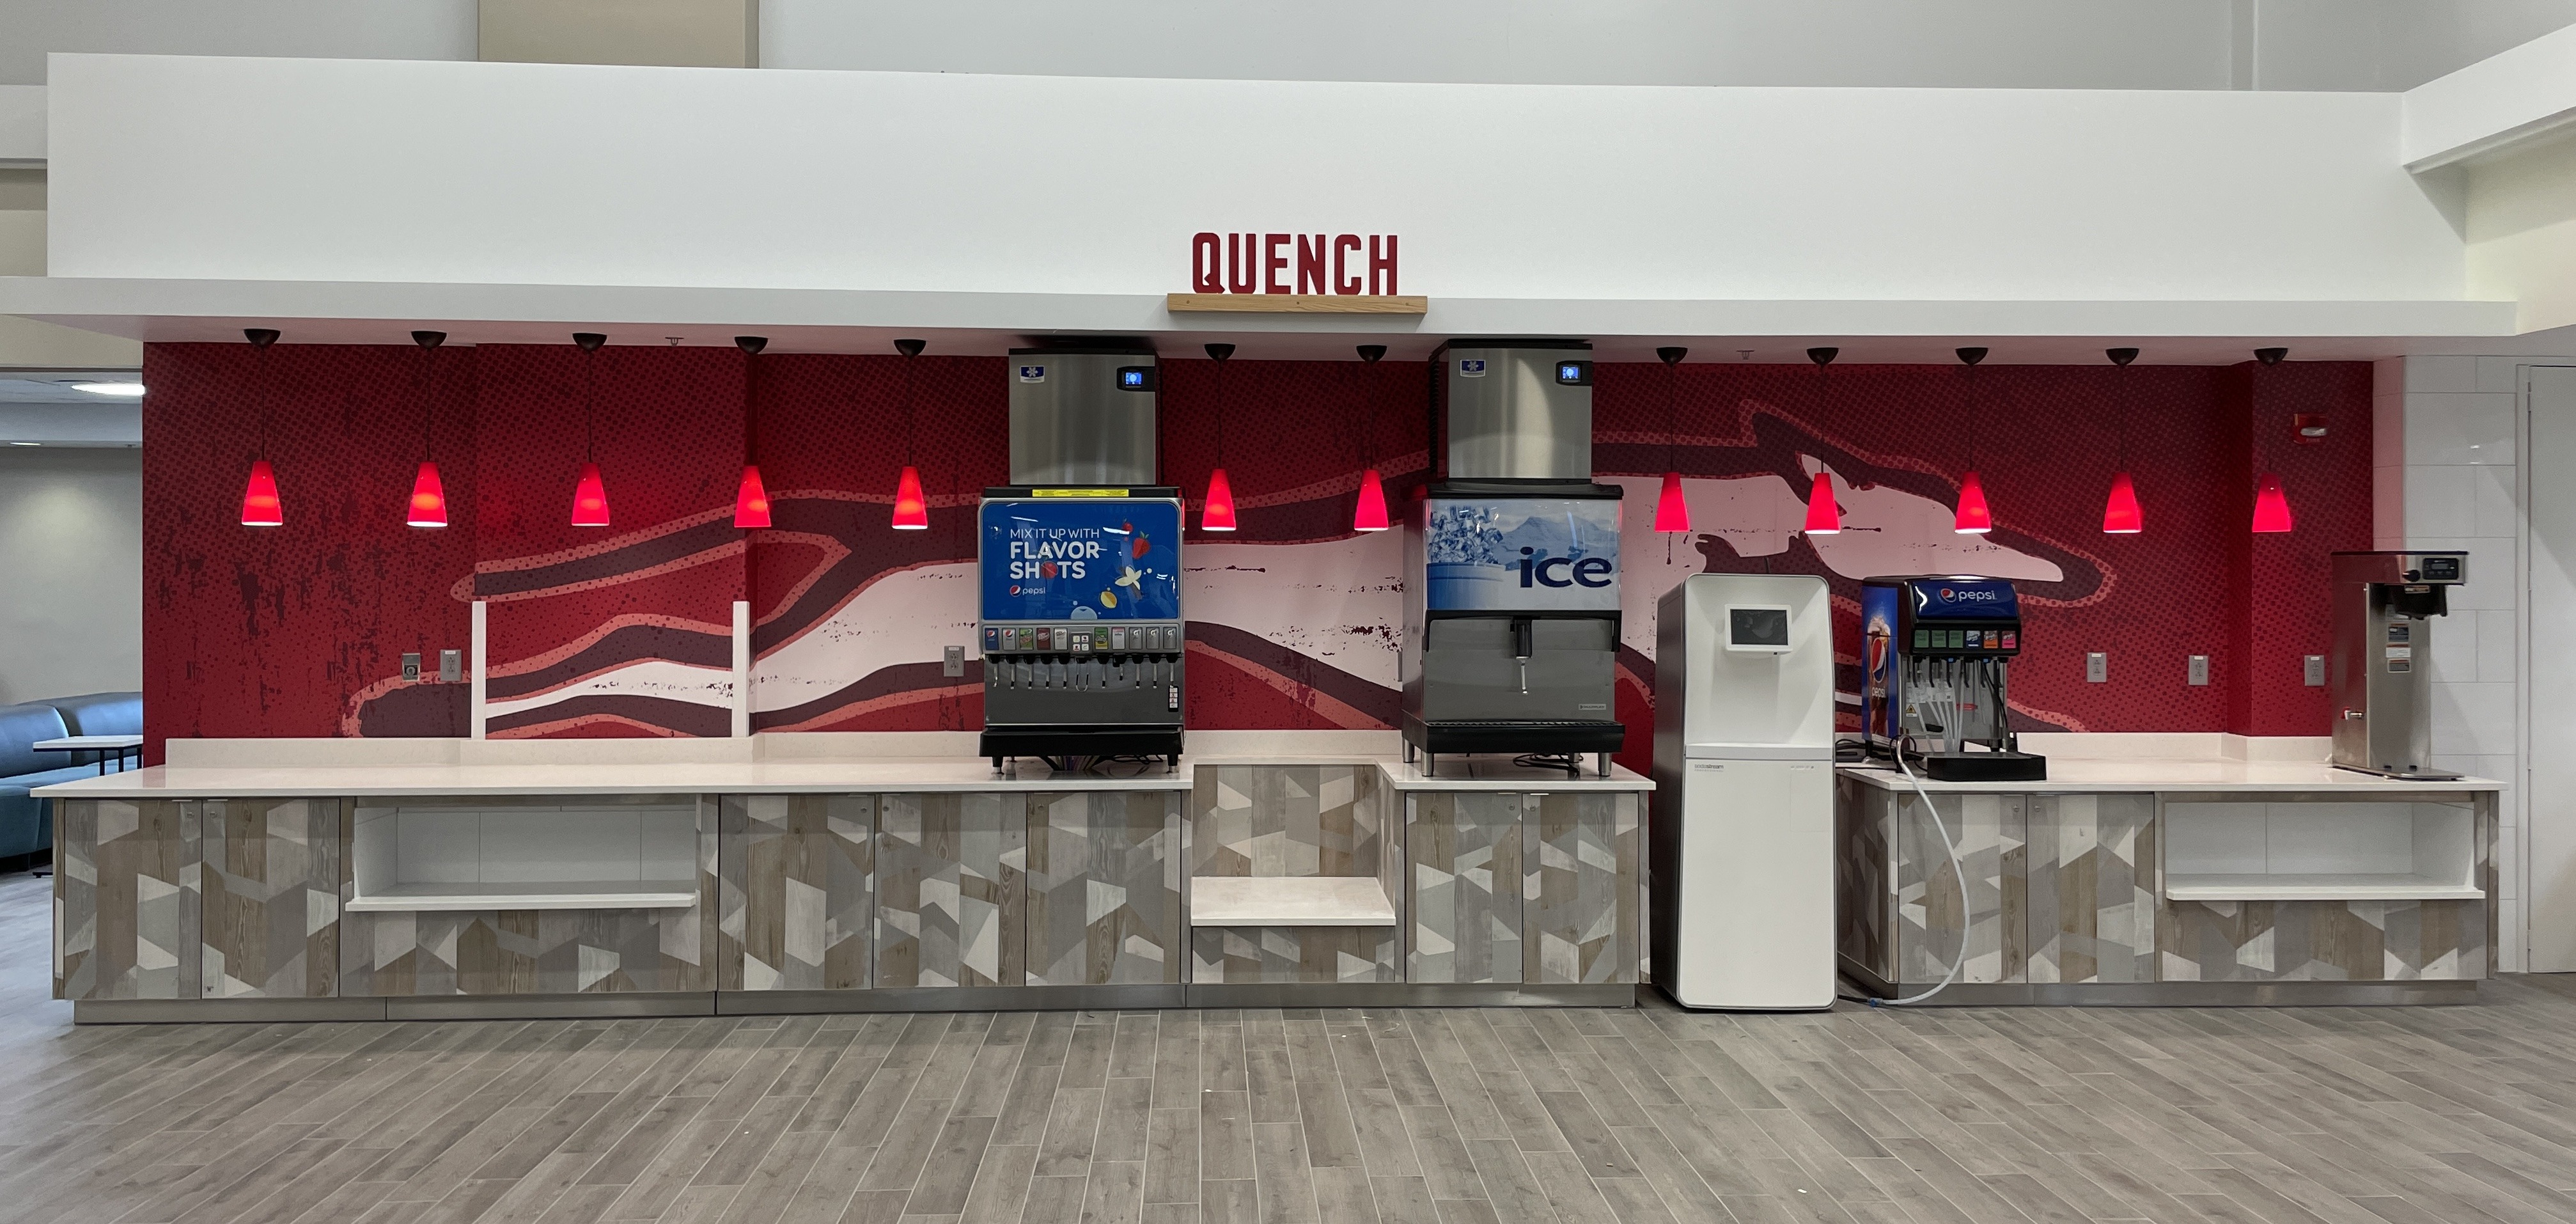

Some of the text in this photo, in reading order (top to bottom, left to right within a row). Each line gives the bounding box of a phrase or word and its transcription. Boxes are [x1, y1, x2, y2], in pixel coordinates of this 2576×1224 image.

[1192, 232, 1398, 295] QUENCH
[1010, 528, 1100, 538] MIX IT UP WITH
[1010, 541, 1100, 560] FLAVOR
[1519, 546, 1612, 588] ice
[1022, 586, 1046, 595] pepsi
[1958, 590, 1995, 602] pepsi
